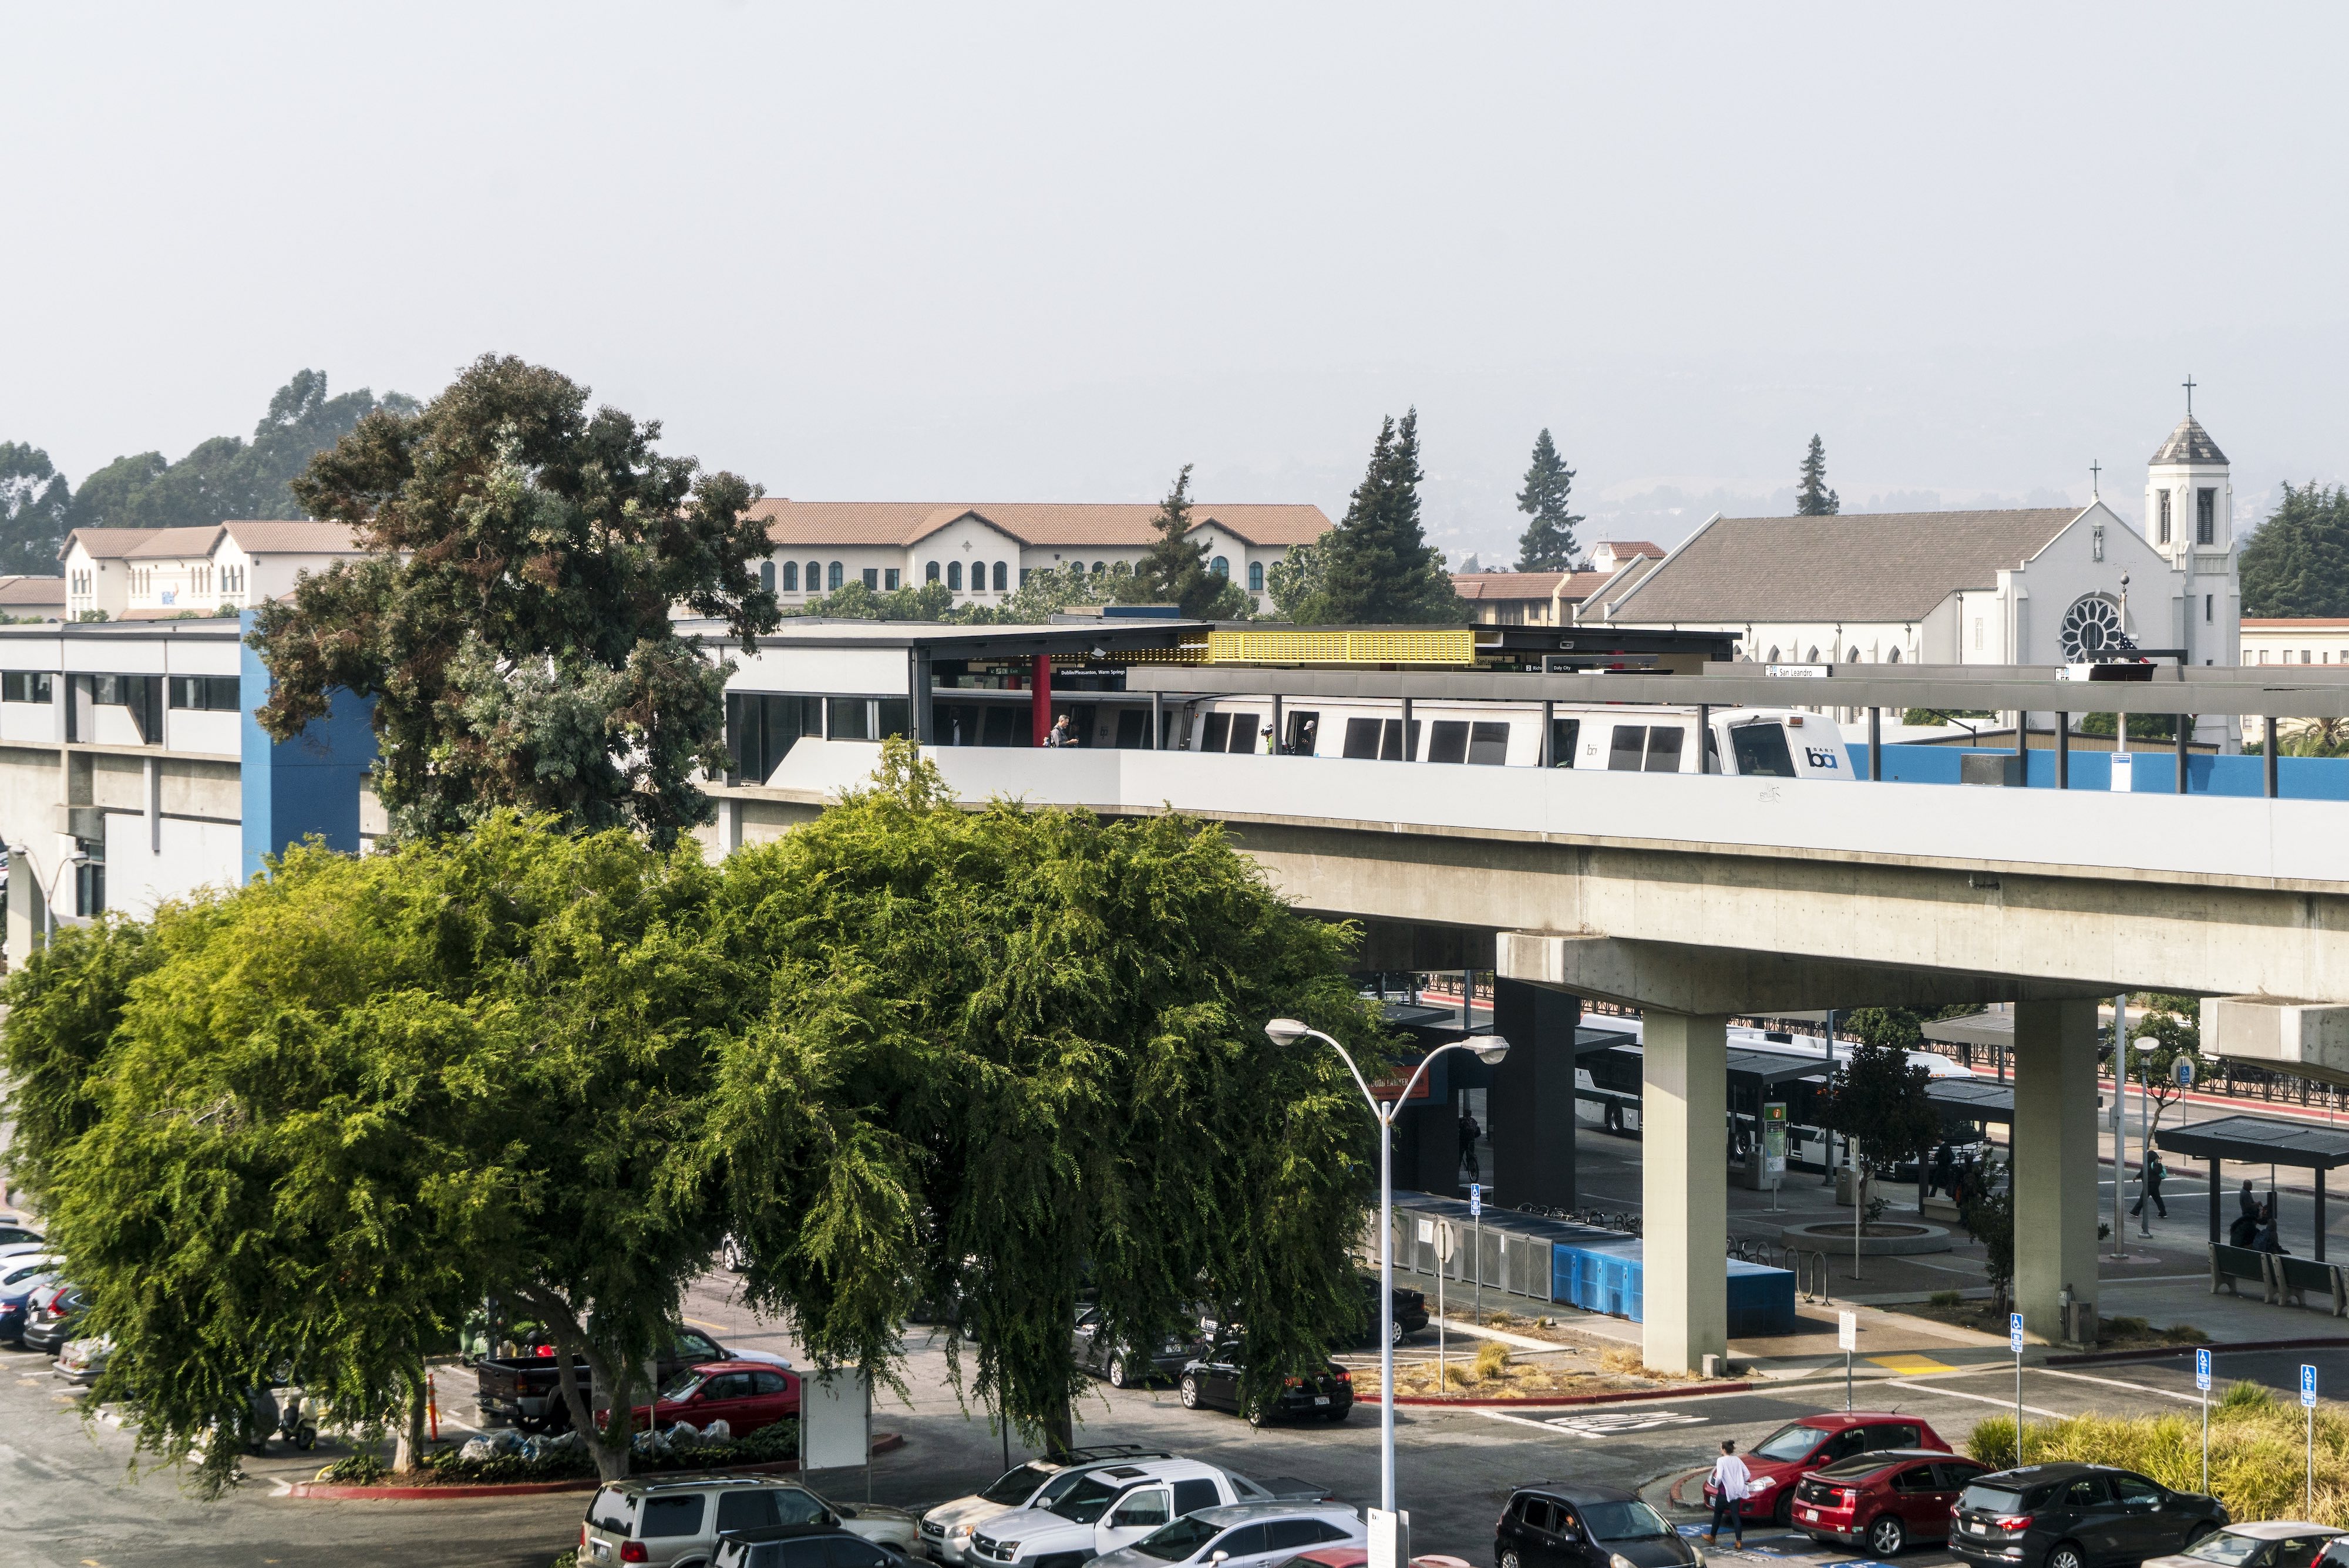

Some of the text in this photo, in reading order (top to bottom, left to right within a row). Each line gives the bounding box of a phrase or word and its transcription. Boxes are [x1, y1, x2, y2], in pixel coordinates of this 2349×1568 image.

[1779, 668, 1812, 677] San Leandro
[1703, 1546, 1770, 1562] PARKING
